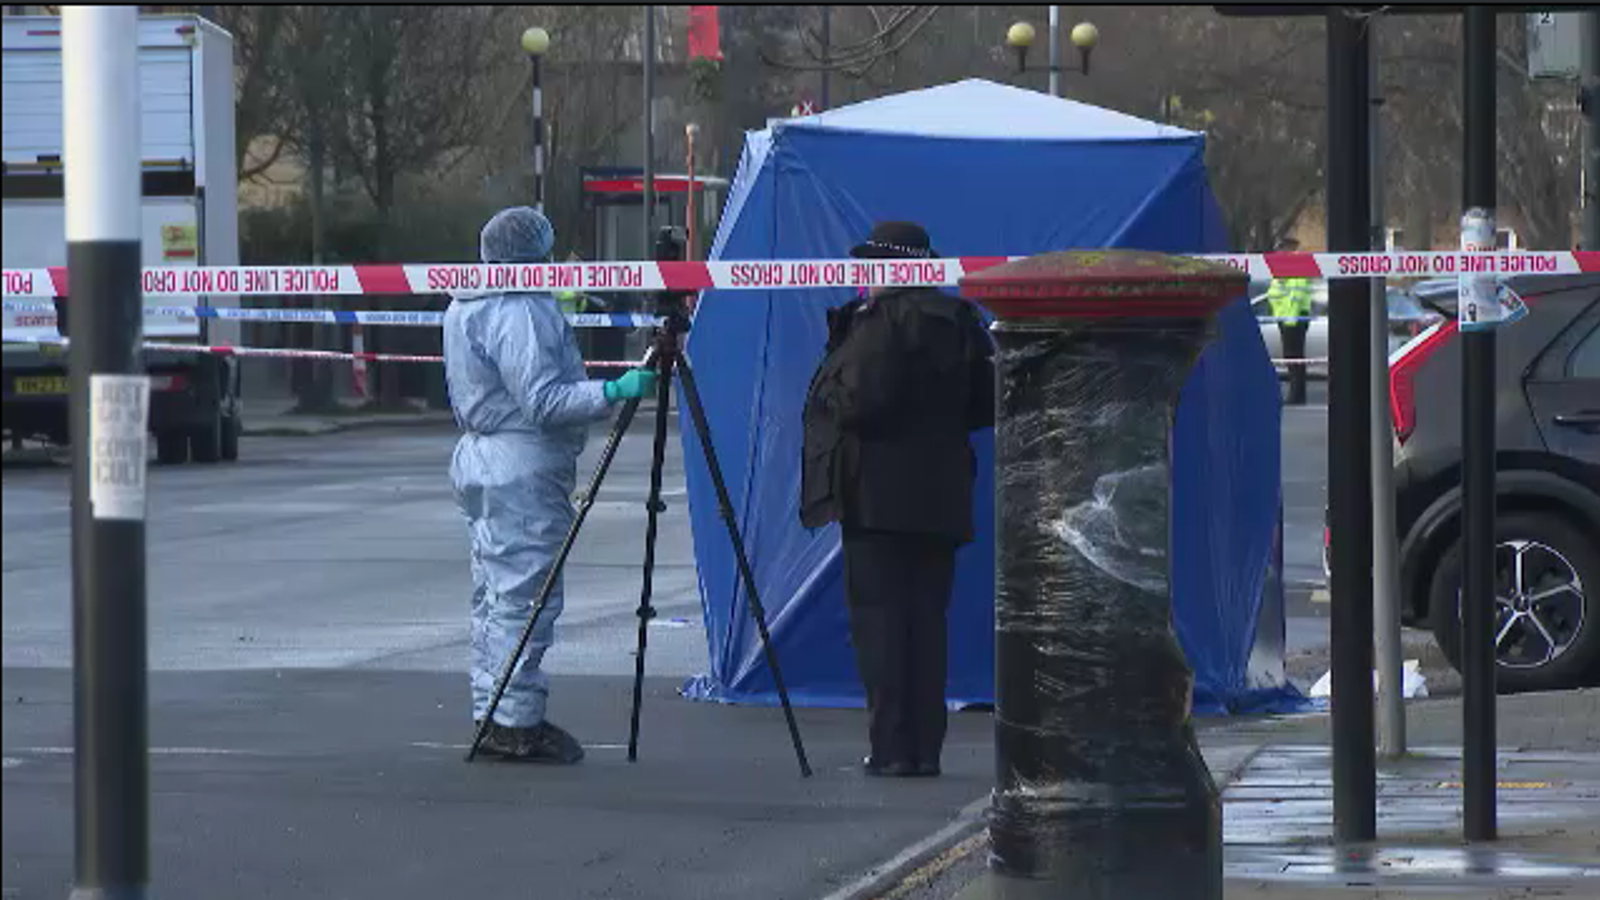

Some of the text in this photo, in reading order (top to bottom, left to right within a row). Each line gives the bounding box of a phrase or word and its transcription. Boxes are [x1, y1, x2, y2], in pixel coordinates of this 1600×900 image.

[730, 262, 945, 286] POLICE LINE DO NOT CROSS
[1337, 255, 1557, 274] POLICE LINE DO NOT CROSS
[180, 270, 213, 292] NOT
[217, 270, 239, 292] DO
[244, 270, 279, 292] LINE
[285, 270, 339, 292] POLICE
[427, 265, 642, 290] POLICE LINE DO NOT CROSS
